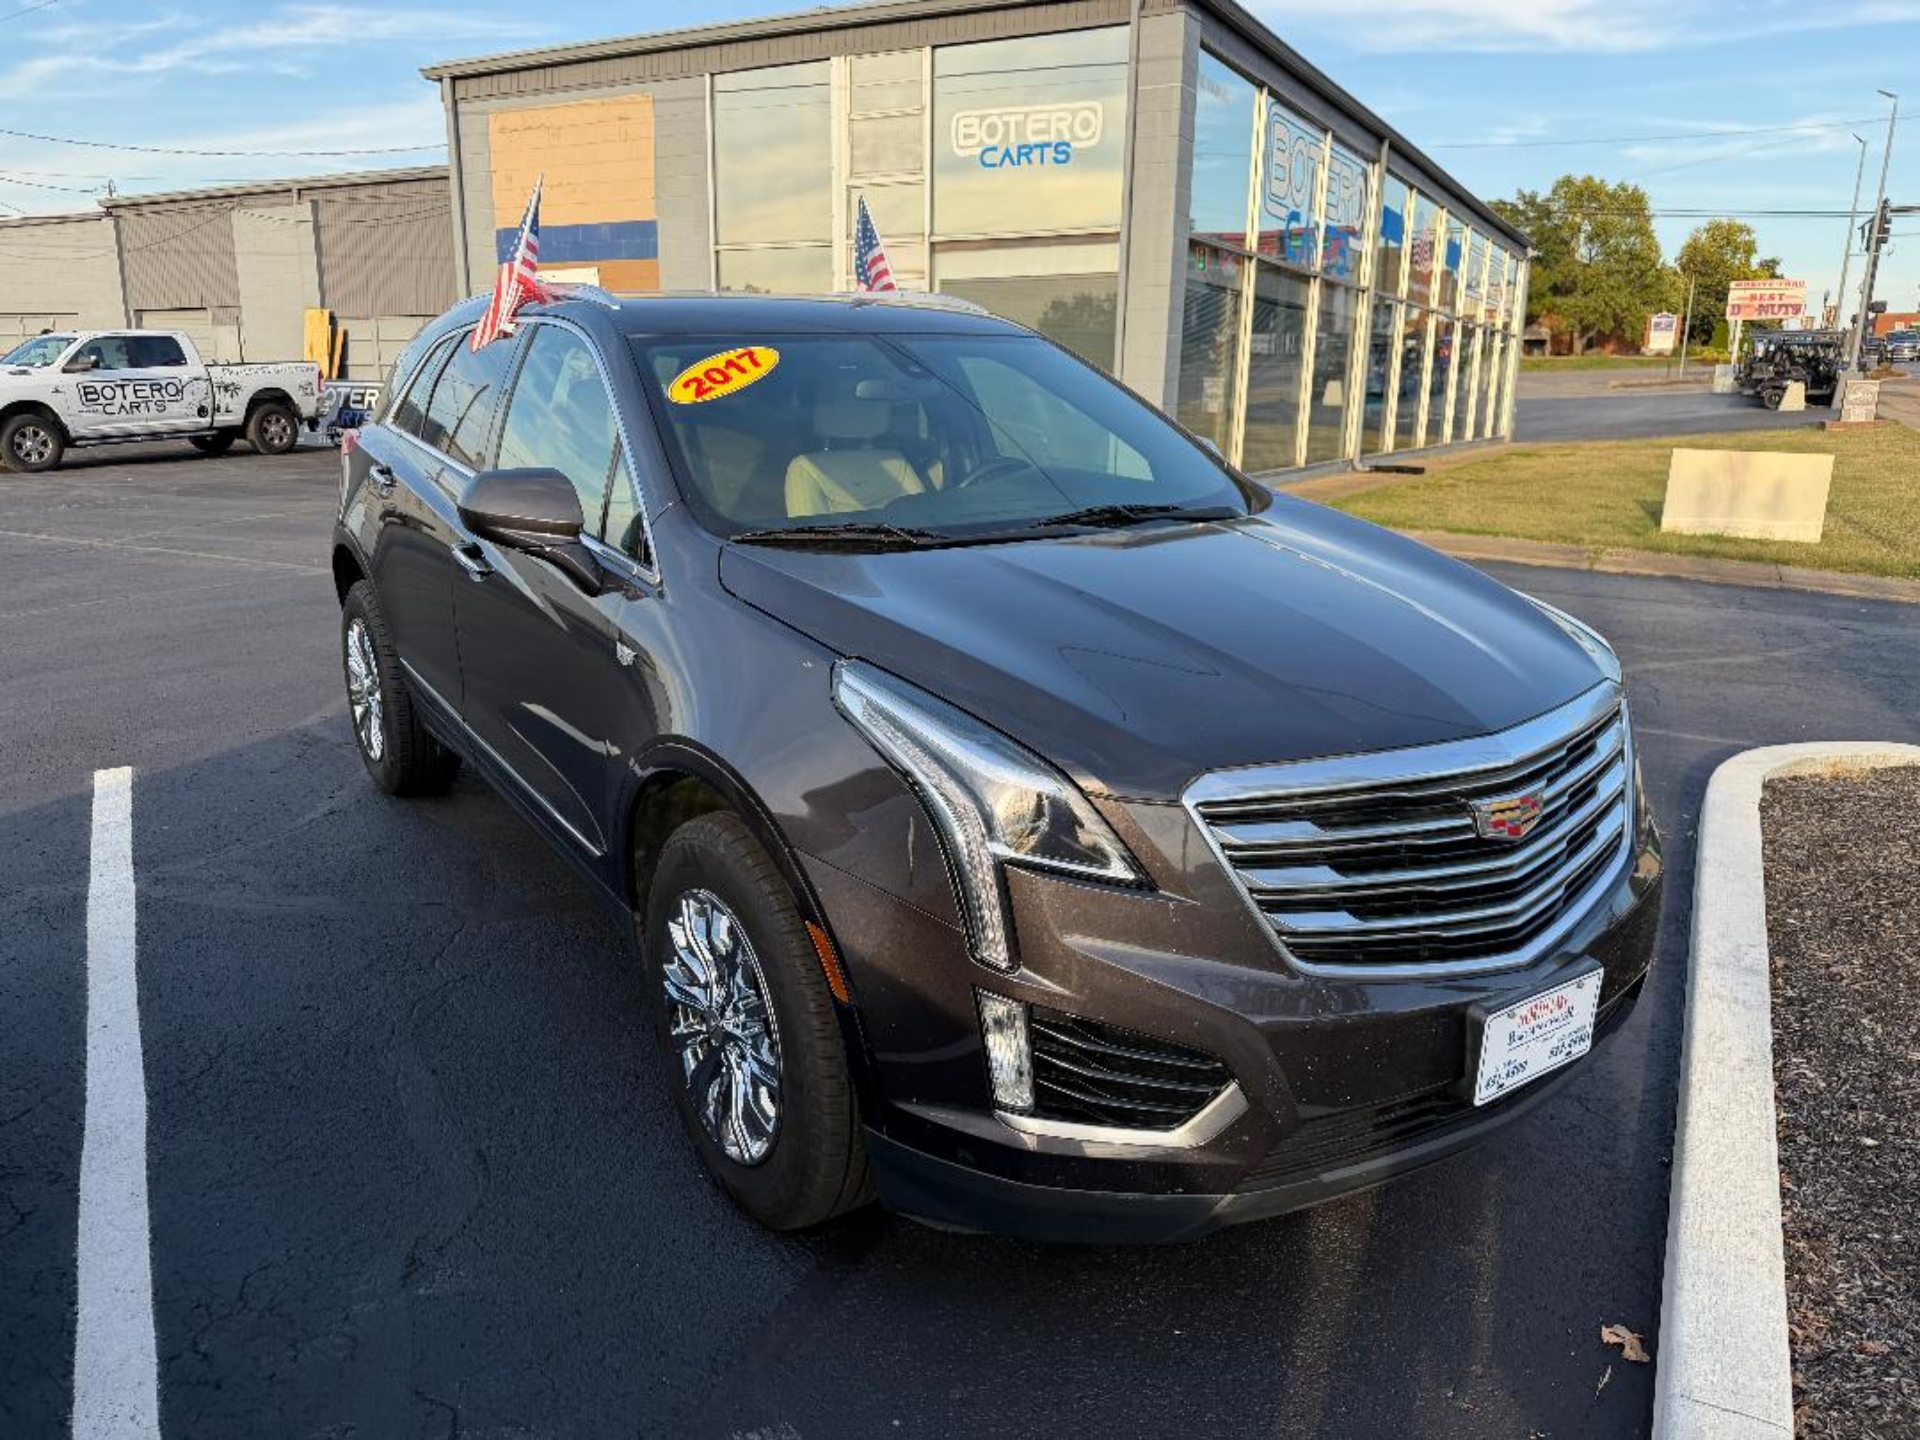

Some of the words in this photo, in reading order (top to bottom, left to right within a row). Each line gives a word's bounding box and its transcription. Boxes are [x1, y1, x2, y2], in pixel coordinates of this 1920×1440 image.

[957, 109, 1098, 147] BOTERO
[979, 141, 1072, 168] CARTS
[1749, 292, 1786, 302] BEST
[682, 349, 762, 399] 2017
[82, 381, 180, 402] BOTERO
[324, 387, 380, 410] OTER
[103, 400, 166, 415] CARTS
